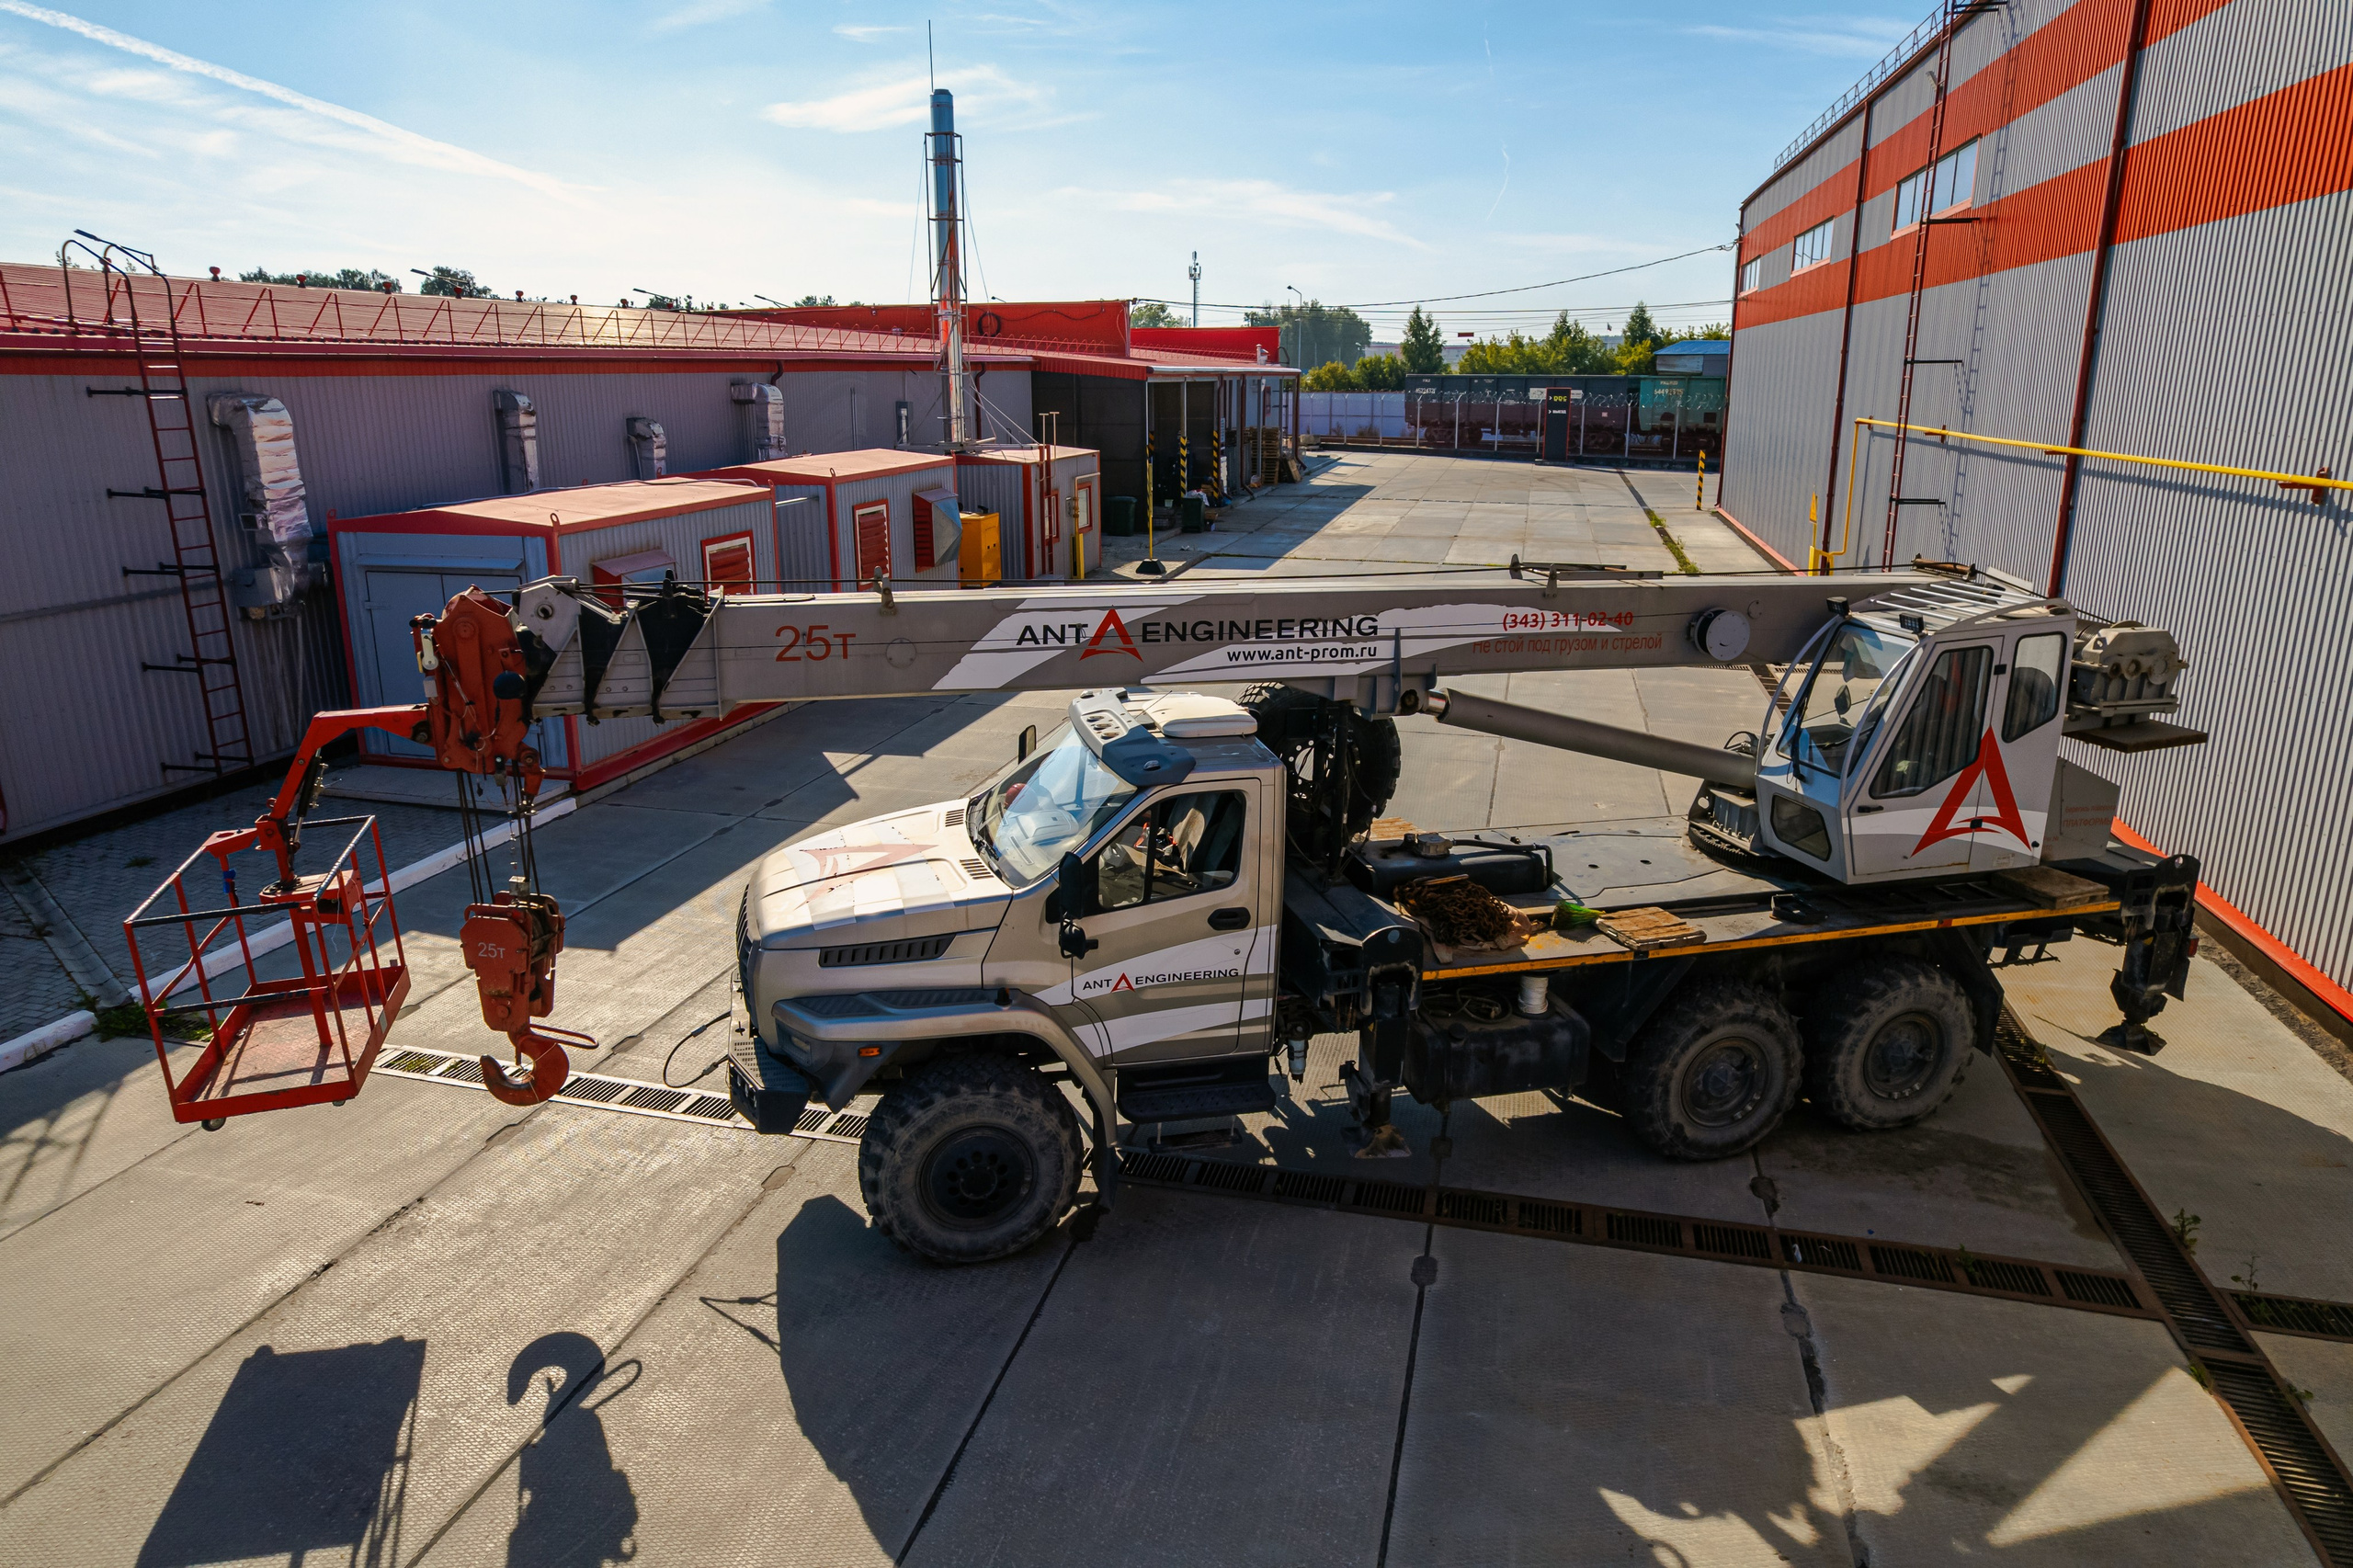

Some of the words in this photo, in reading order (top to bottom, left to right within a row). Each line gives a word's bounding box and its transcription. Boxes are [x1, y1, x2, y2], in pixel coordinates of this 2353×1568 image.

[1016, 622, 1088, 646] ANT
[1142, 616, 1379, 643] ENGINEERING
[1502, 612, 1546, 631] (343)
[1551, 611, 1633, 628] 311-02-40
[1227, 644, 1378, 663] www.ant-prom.ru
[1472, 639, 1491, 653] Не
[1495, 635, 1524, 653] стой
[1527, 640, 1551, 654] под
[1554, 638, 1597, 655] грузом
[1600, 637, 1608, 651] и
[1612, 633, 1663, 654] стрелой
[1082, 978, 1112, 991] ANT
[1135, 968, 1239, 985] ENGINEERING
